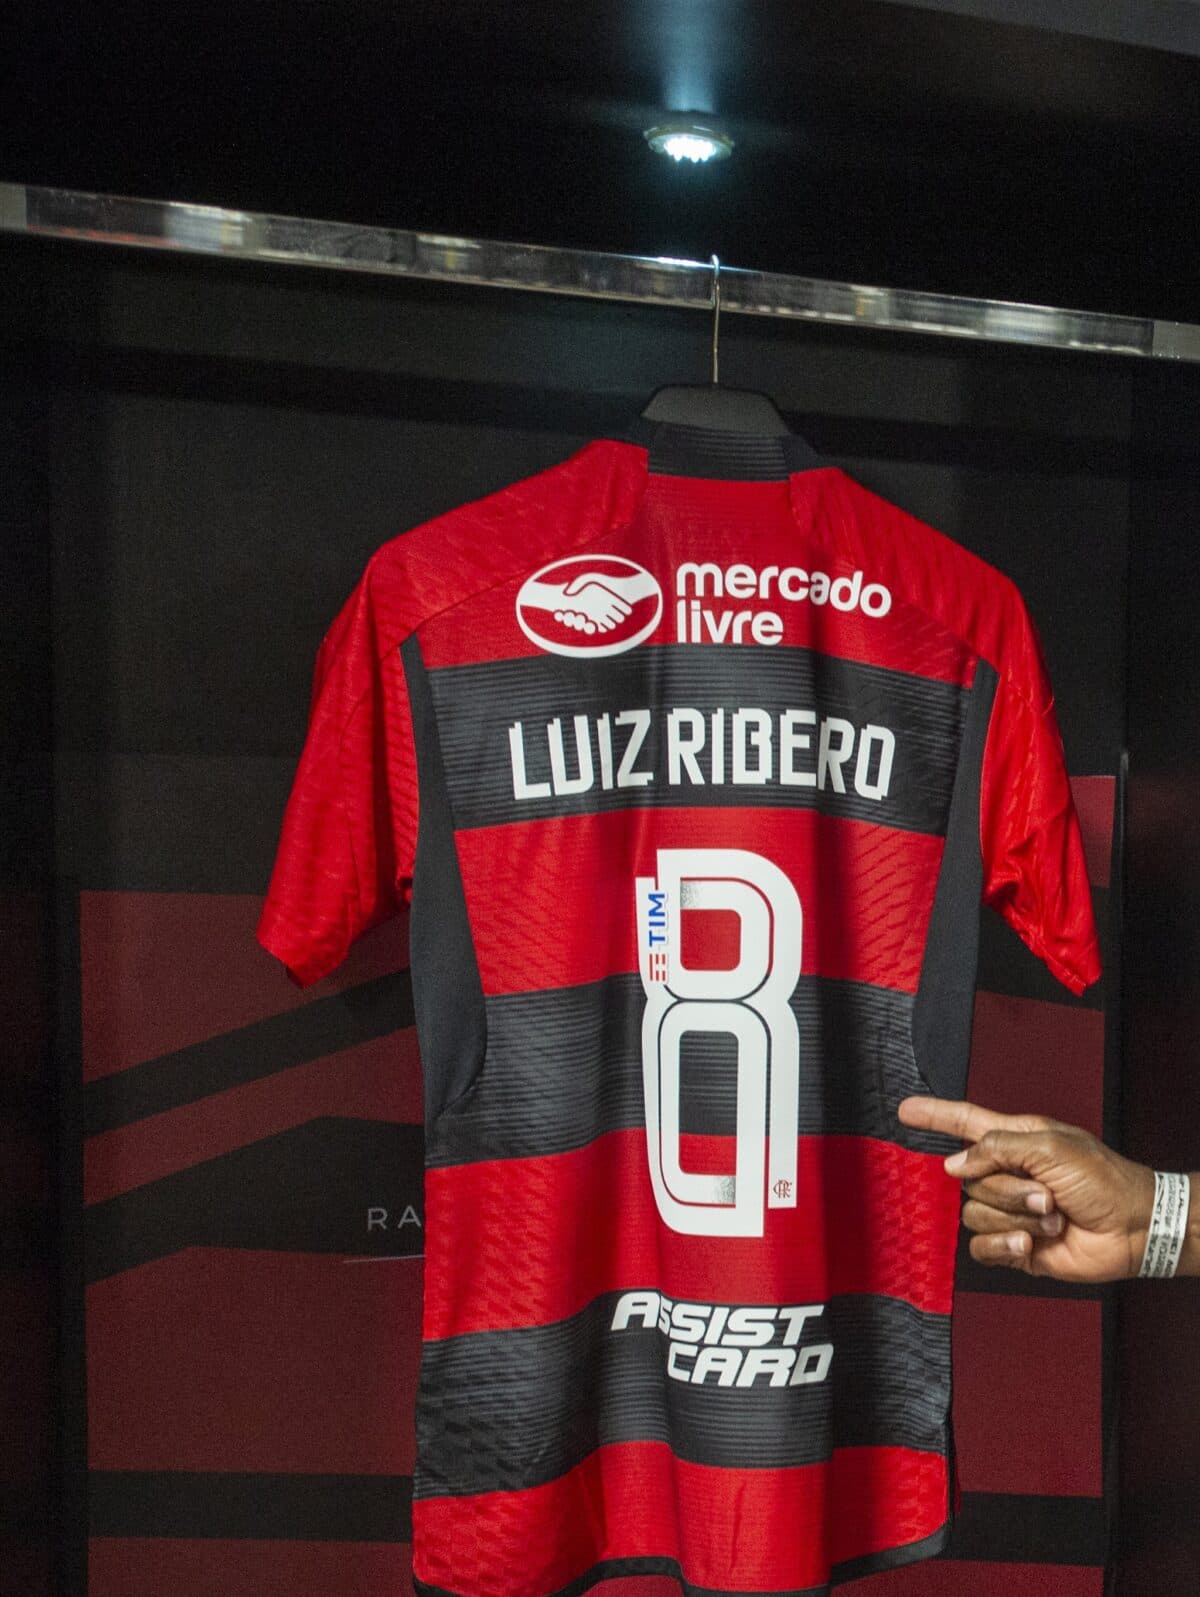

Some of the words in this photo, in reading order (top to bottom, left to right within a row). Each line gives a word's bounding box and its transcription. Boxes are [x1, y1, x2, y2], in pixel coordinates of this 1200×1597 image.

[676, 562, 892, 618] mercado
[676, 600, 784, 645] livre
[509, 708, 654, 800] LUIZ
[667, 707, 896, 801] RIBERO
[648, 893, 666, 948] TIM
[635, 848, 803, 1237] 8
[611, 1291, 825, 1346] ASSIST
[667, 1341, 834, 1387] CARD
